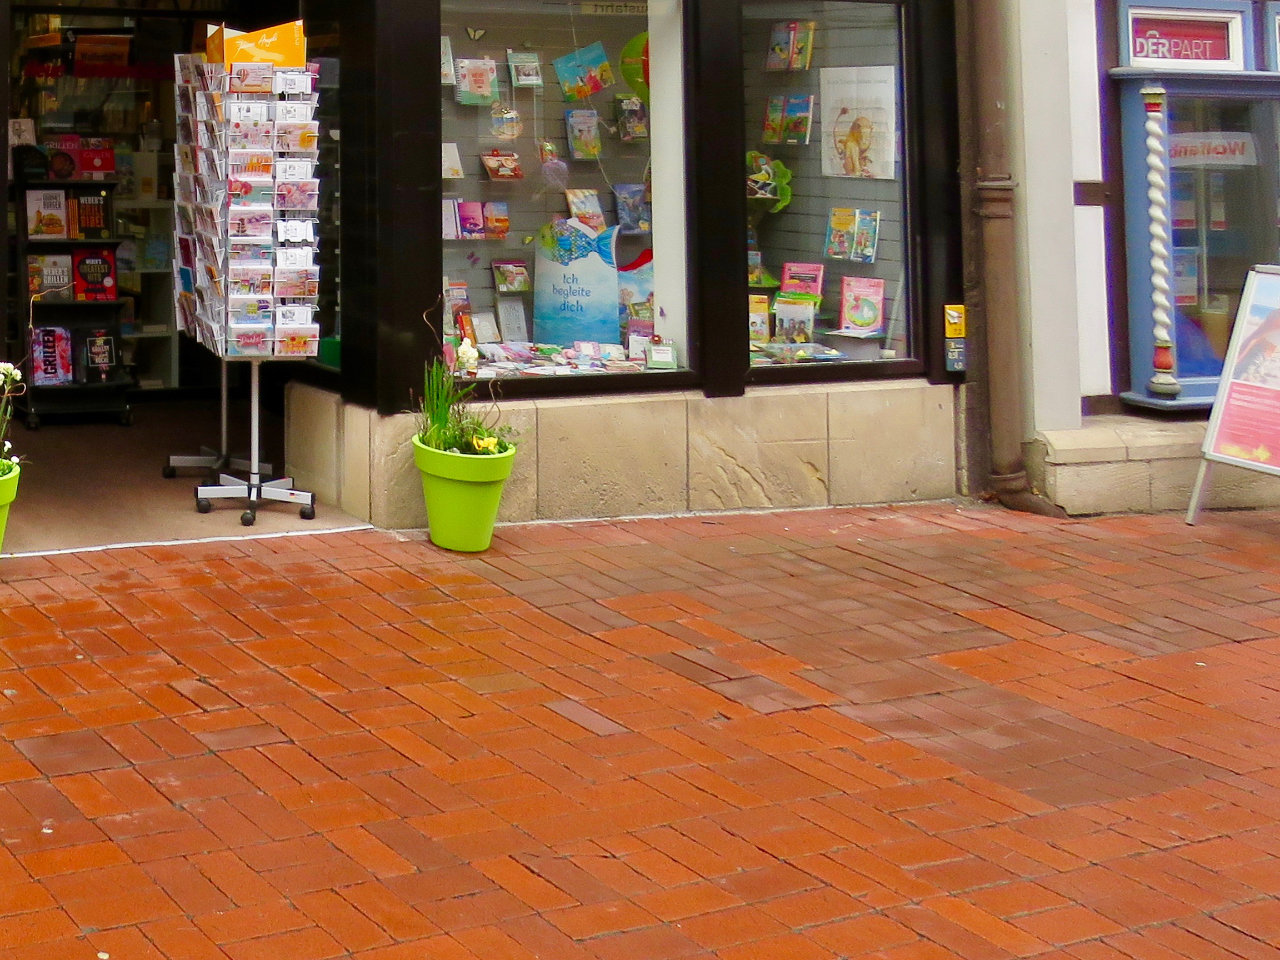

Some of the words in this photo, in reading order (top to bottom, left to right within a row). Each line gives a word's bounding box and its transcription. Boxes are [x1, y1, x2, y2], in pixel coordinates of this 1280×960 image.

[1136, 36, 1213, 59] DERPART
[562, 273, 579, 285] Ich
[552, 284, 592, 299] begleite
[559, 301, 584, 313] dich
[42, 328, 58, 376] GRILLEN
